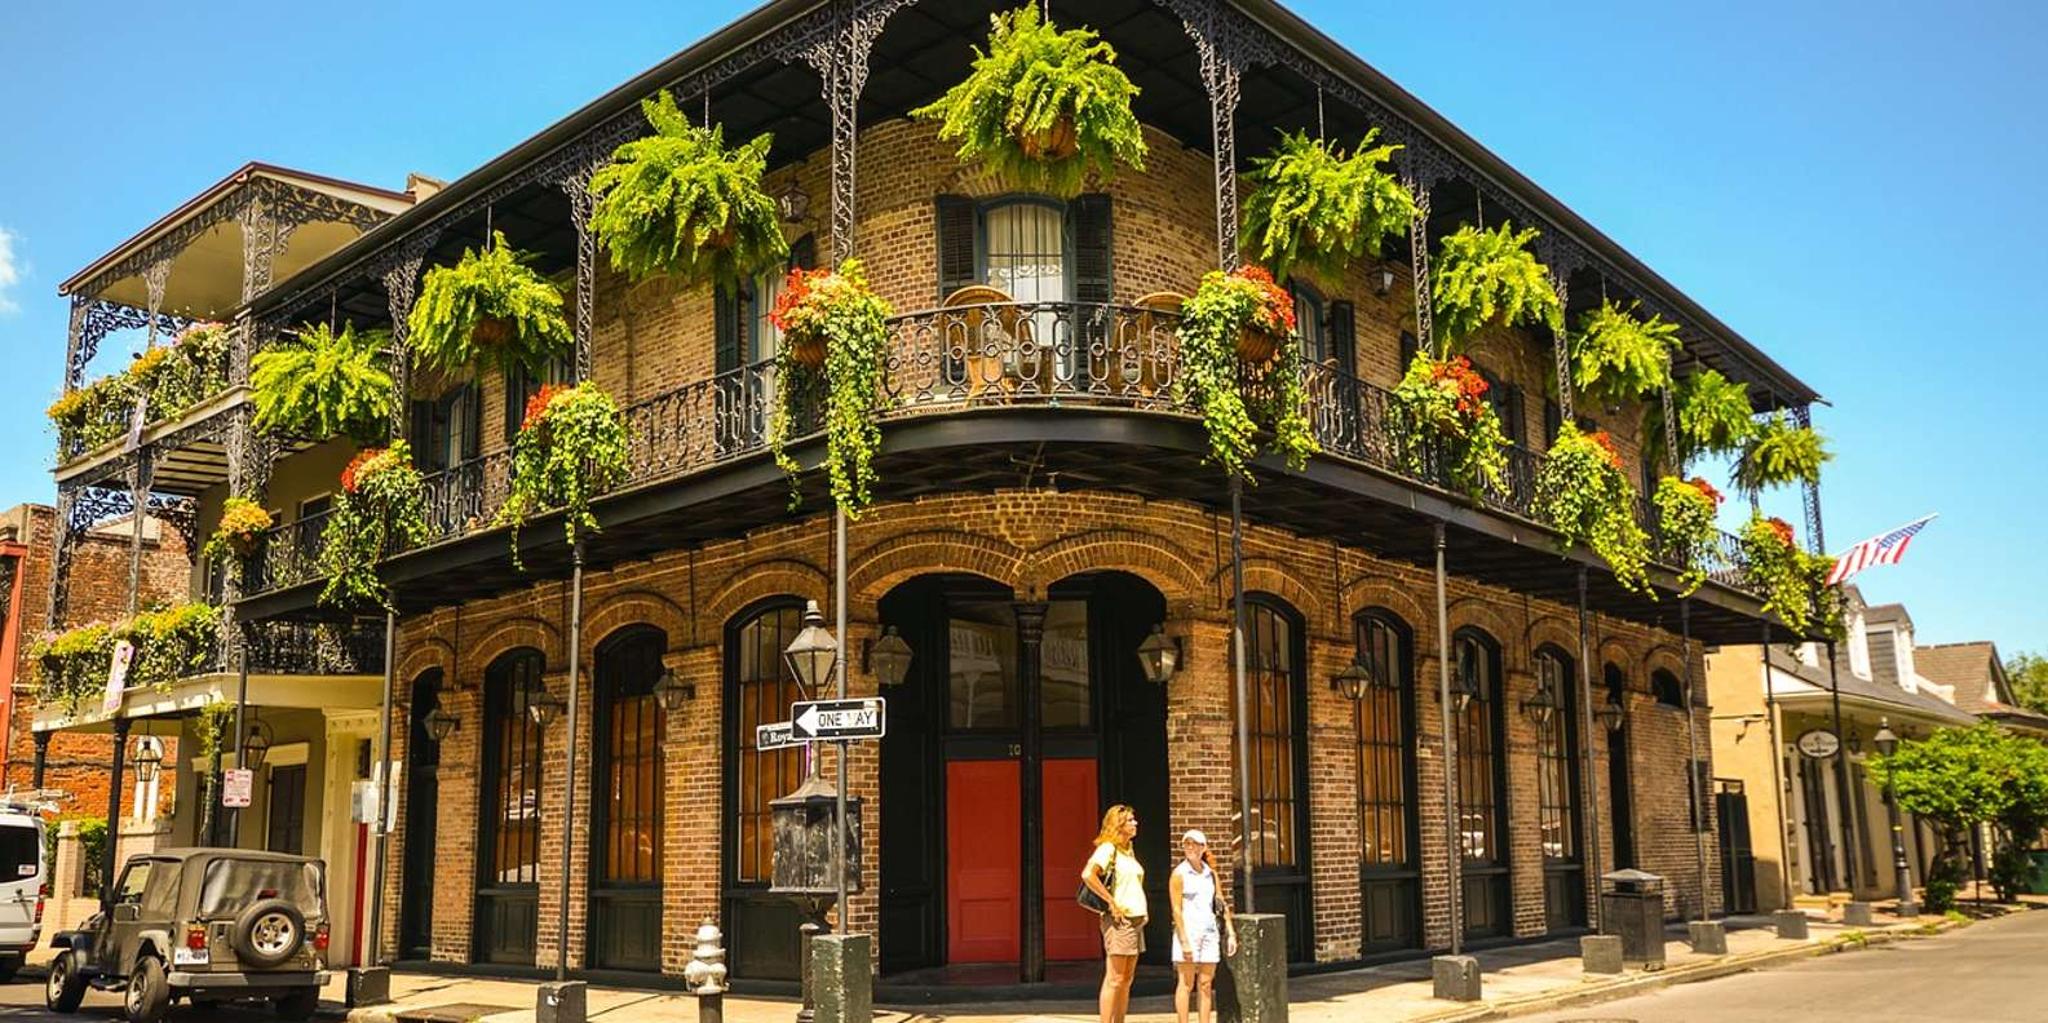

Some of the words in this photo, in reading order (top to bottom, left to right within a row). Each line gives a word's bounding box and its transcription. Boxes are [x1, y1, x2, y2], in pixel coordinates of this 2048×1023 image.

[818, 712, 842, 727] ONE
[846, 710, 874, 726] AY
[770, 731, 793, 746] Roya
